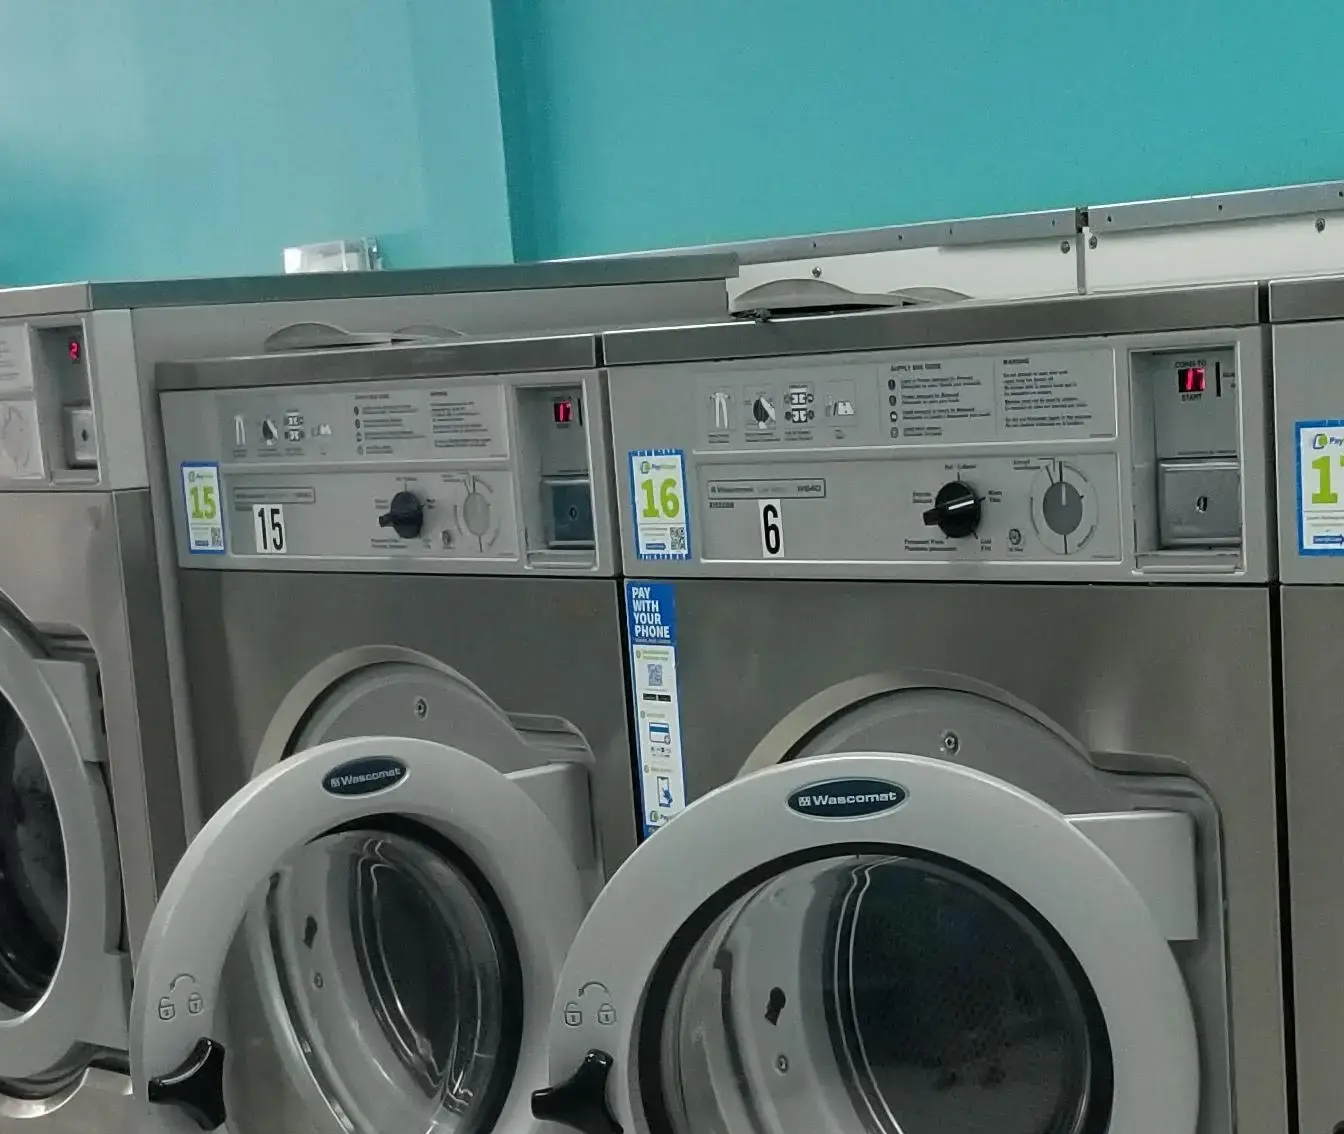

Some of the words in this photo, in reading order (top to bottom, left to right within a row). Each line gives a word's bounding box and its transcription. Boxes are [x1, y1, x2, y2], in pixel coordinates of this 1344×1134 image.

[190, 486, 216, 519] 15
[641, 478, 679, 518] 16
[258, 508, 283, 550] 15
[763, 504, 781, 554] 6
[632, 587, 650, 599] PAY
[633, 600, 659, 612] WITH
[633, 612, 661, 625] YOUR
[635, 625, 670, 638] PHONE
[341, 767, 401, 785] Wascomat
[812, 792, 897, 806] Wascomat
